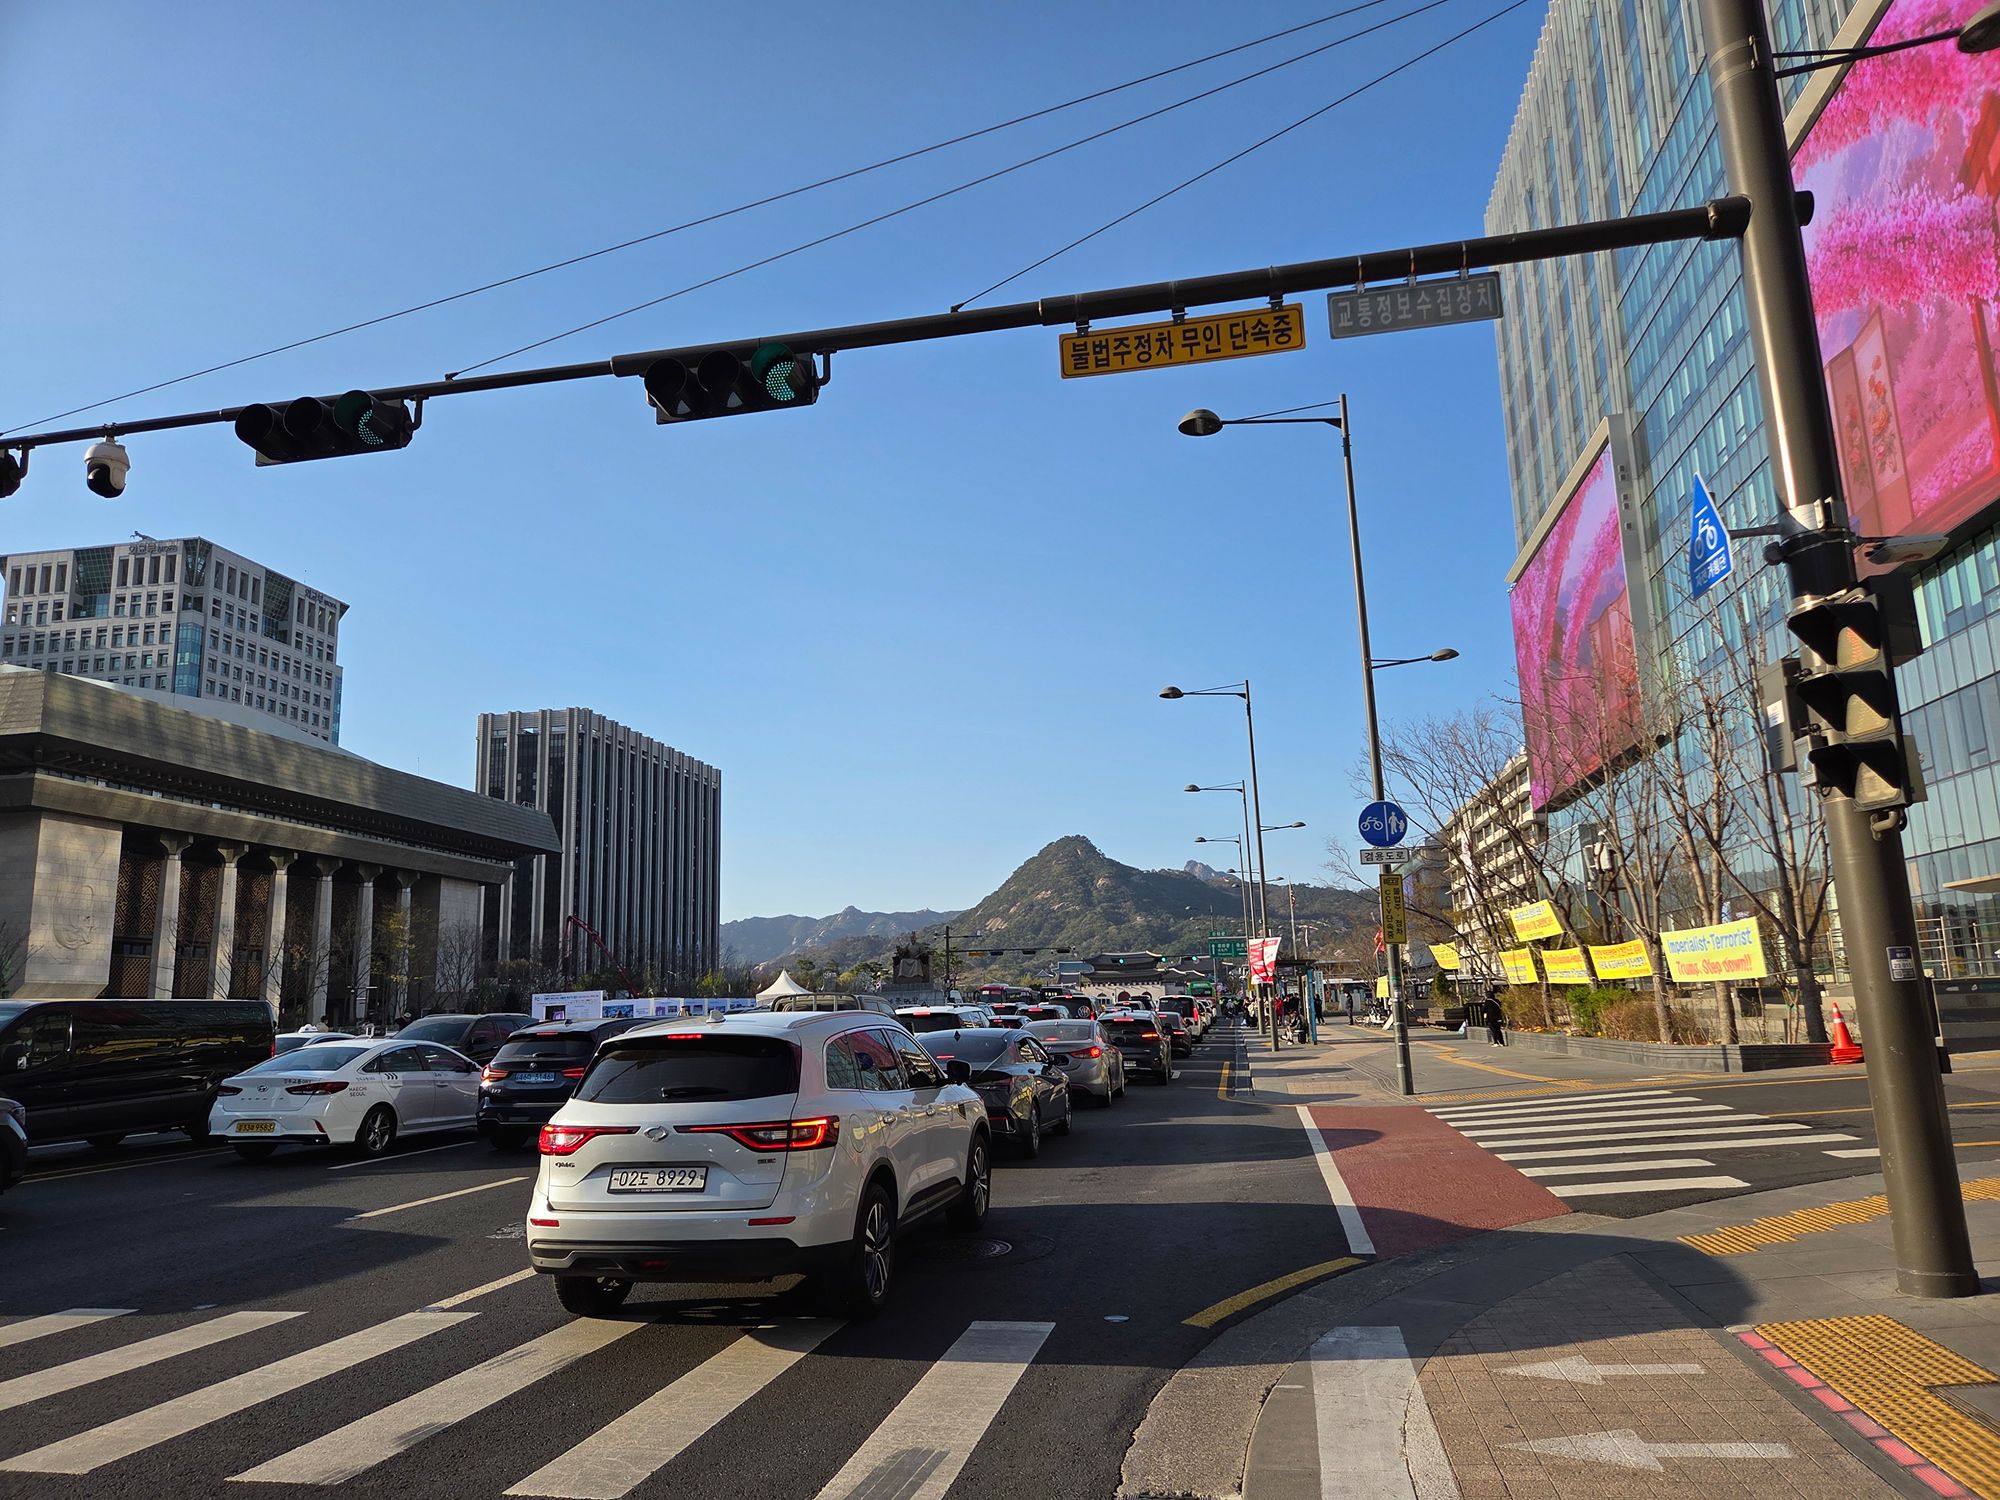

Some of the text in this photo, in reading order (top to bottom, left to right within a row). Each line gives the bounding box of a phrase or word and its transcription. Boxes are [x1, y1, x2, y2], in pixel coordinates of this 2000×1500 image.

[1337, 280, 1493, 328] 교통정보수집장치
[1070, 314, 1293, 370] 불법주정차 무인 단속중
[1364, 851, 1406, 862] 겸용도로
[1701, 957, 1722, 975] Step
[619, 1169, 697, 1187] 02도 8929
